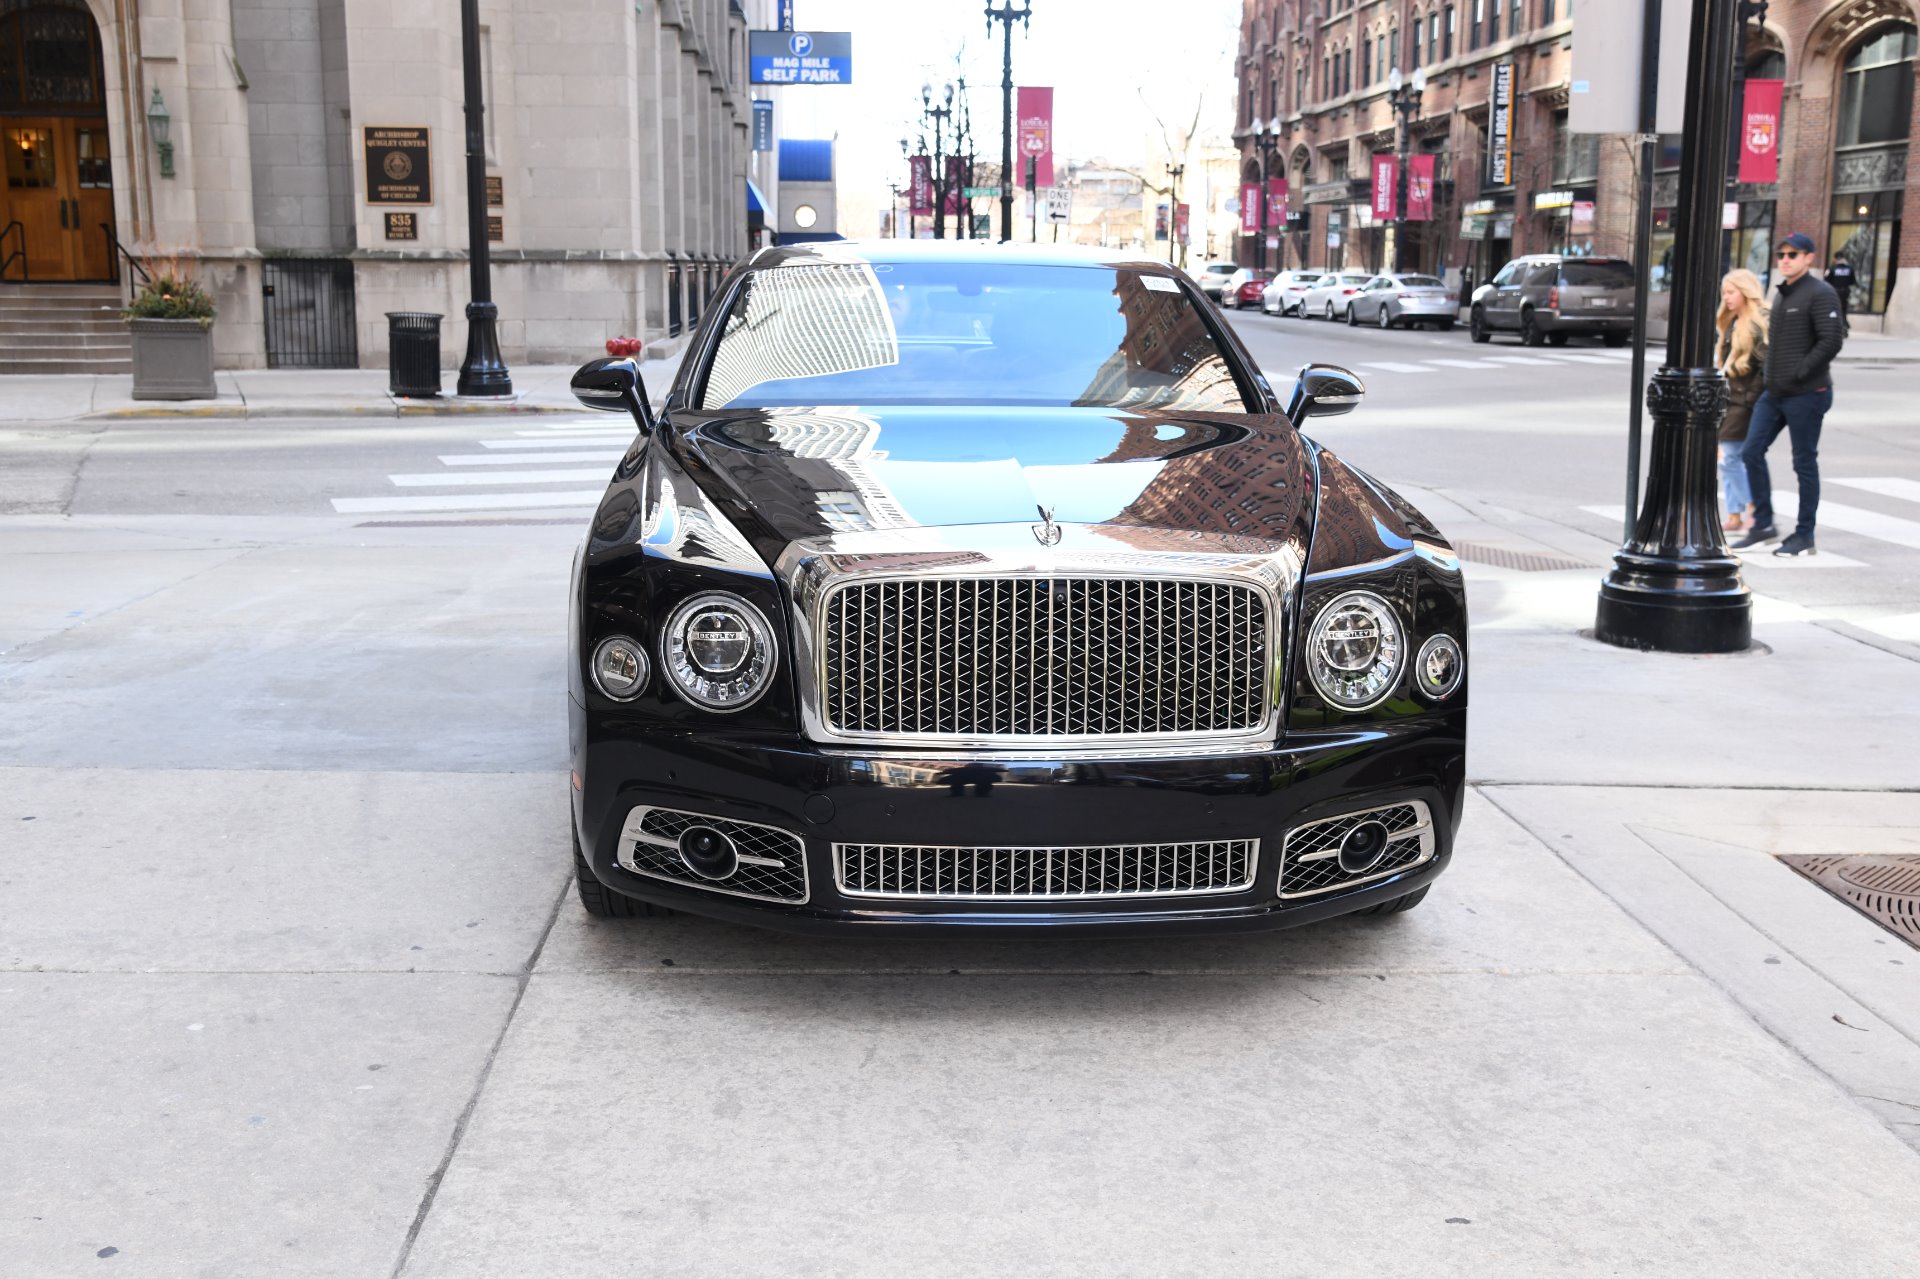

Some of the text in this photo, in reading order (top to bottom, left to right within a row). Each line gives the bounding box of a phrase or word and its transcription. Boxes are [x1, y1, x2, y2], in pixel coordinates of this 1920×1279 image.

[794, 36, 808, 52] P
[772, 58, 830, 68] MAG MILE
[762, 69, 840, 82] SELF PARK
[1497, 65, 1511, 105] BAGELS
[399, 139, 427, 148] CENTER
[1493, 137, 1506, 183] EINSTEIN
[1377, 163, 1387, 213] WELCOME
[1050, 191, 1069, 199] ONE
[1049, 202, 1068, 210] WAY
[389, 214, 412, 226] 835
[699, 632, 736, 640] BENTLEY
